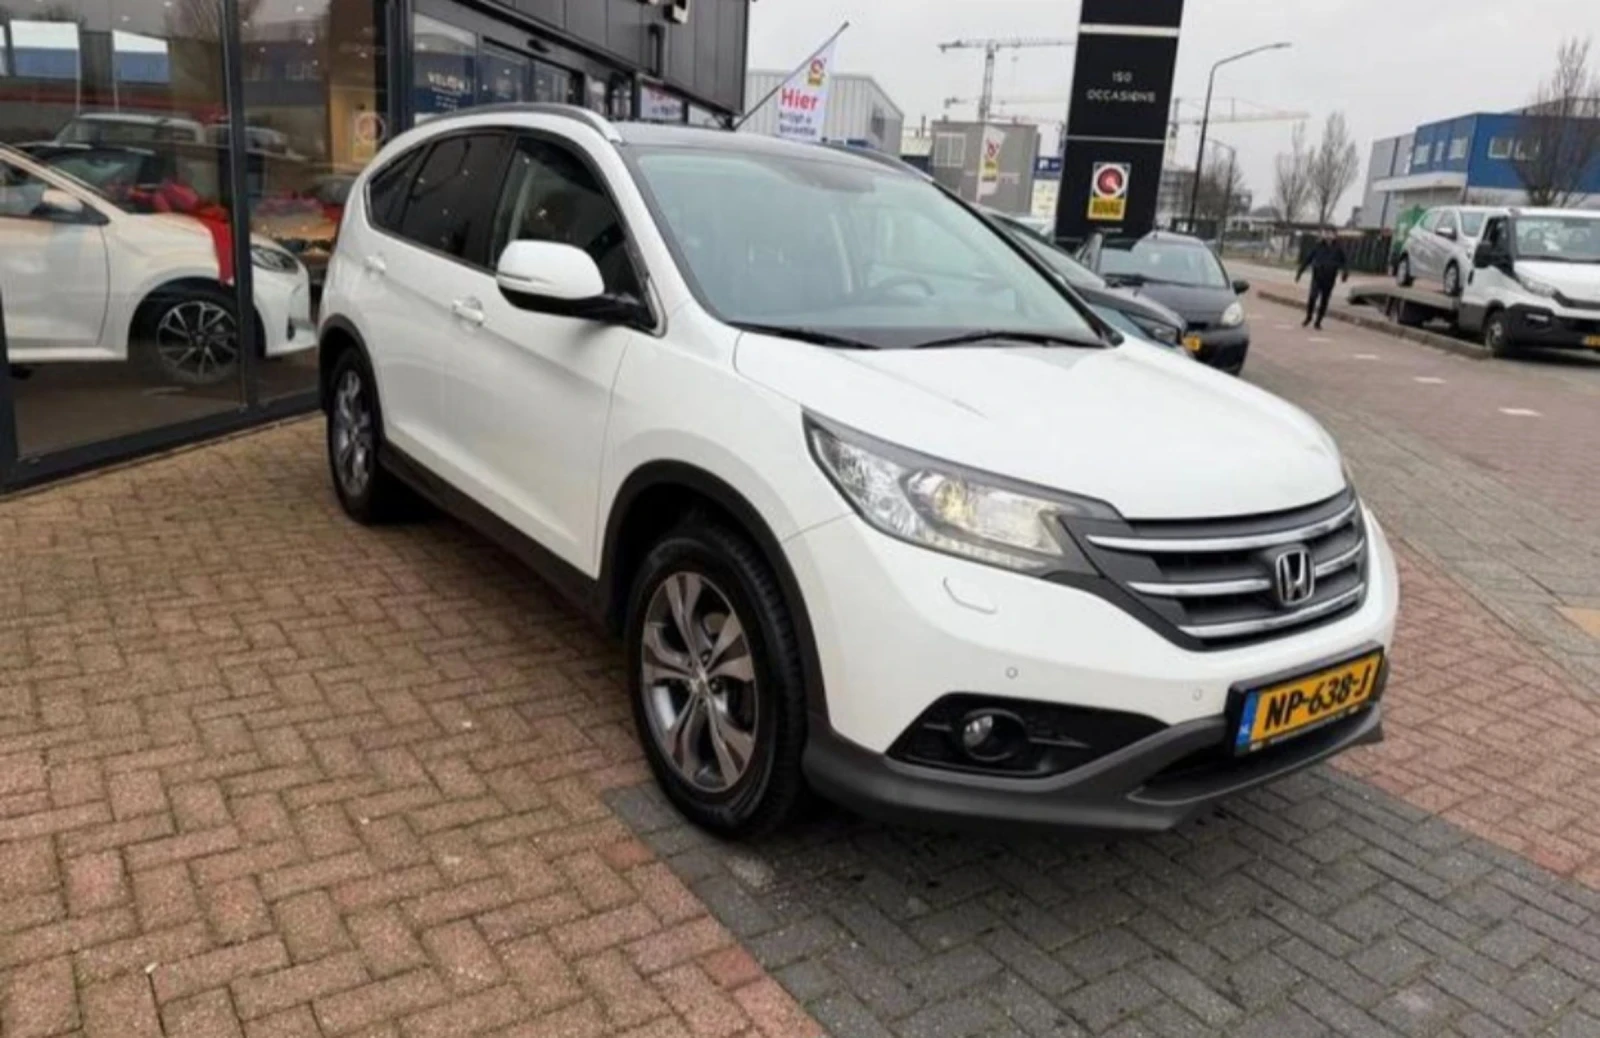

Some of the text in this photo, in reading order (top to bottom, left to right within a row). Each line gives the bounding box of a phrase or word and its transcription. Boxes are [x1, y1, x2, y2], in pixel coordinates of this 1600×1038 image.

[780, 87, 818, 111] Hier
[1086, 88, 1156, 104] OCCASIONS
[1264, 662, 1372, 731] NP-638-J
